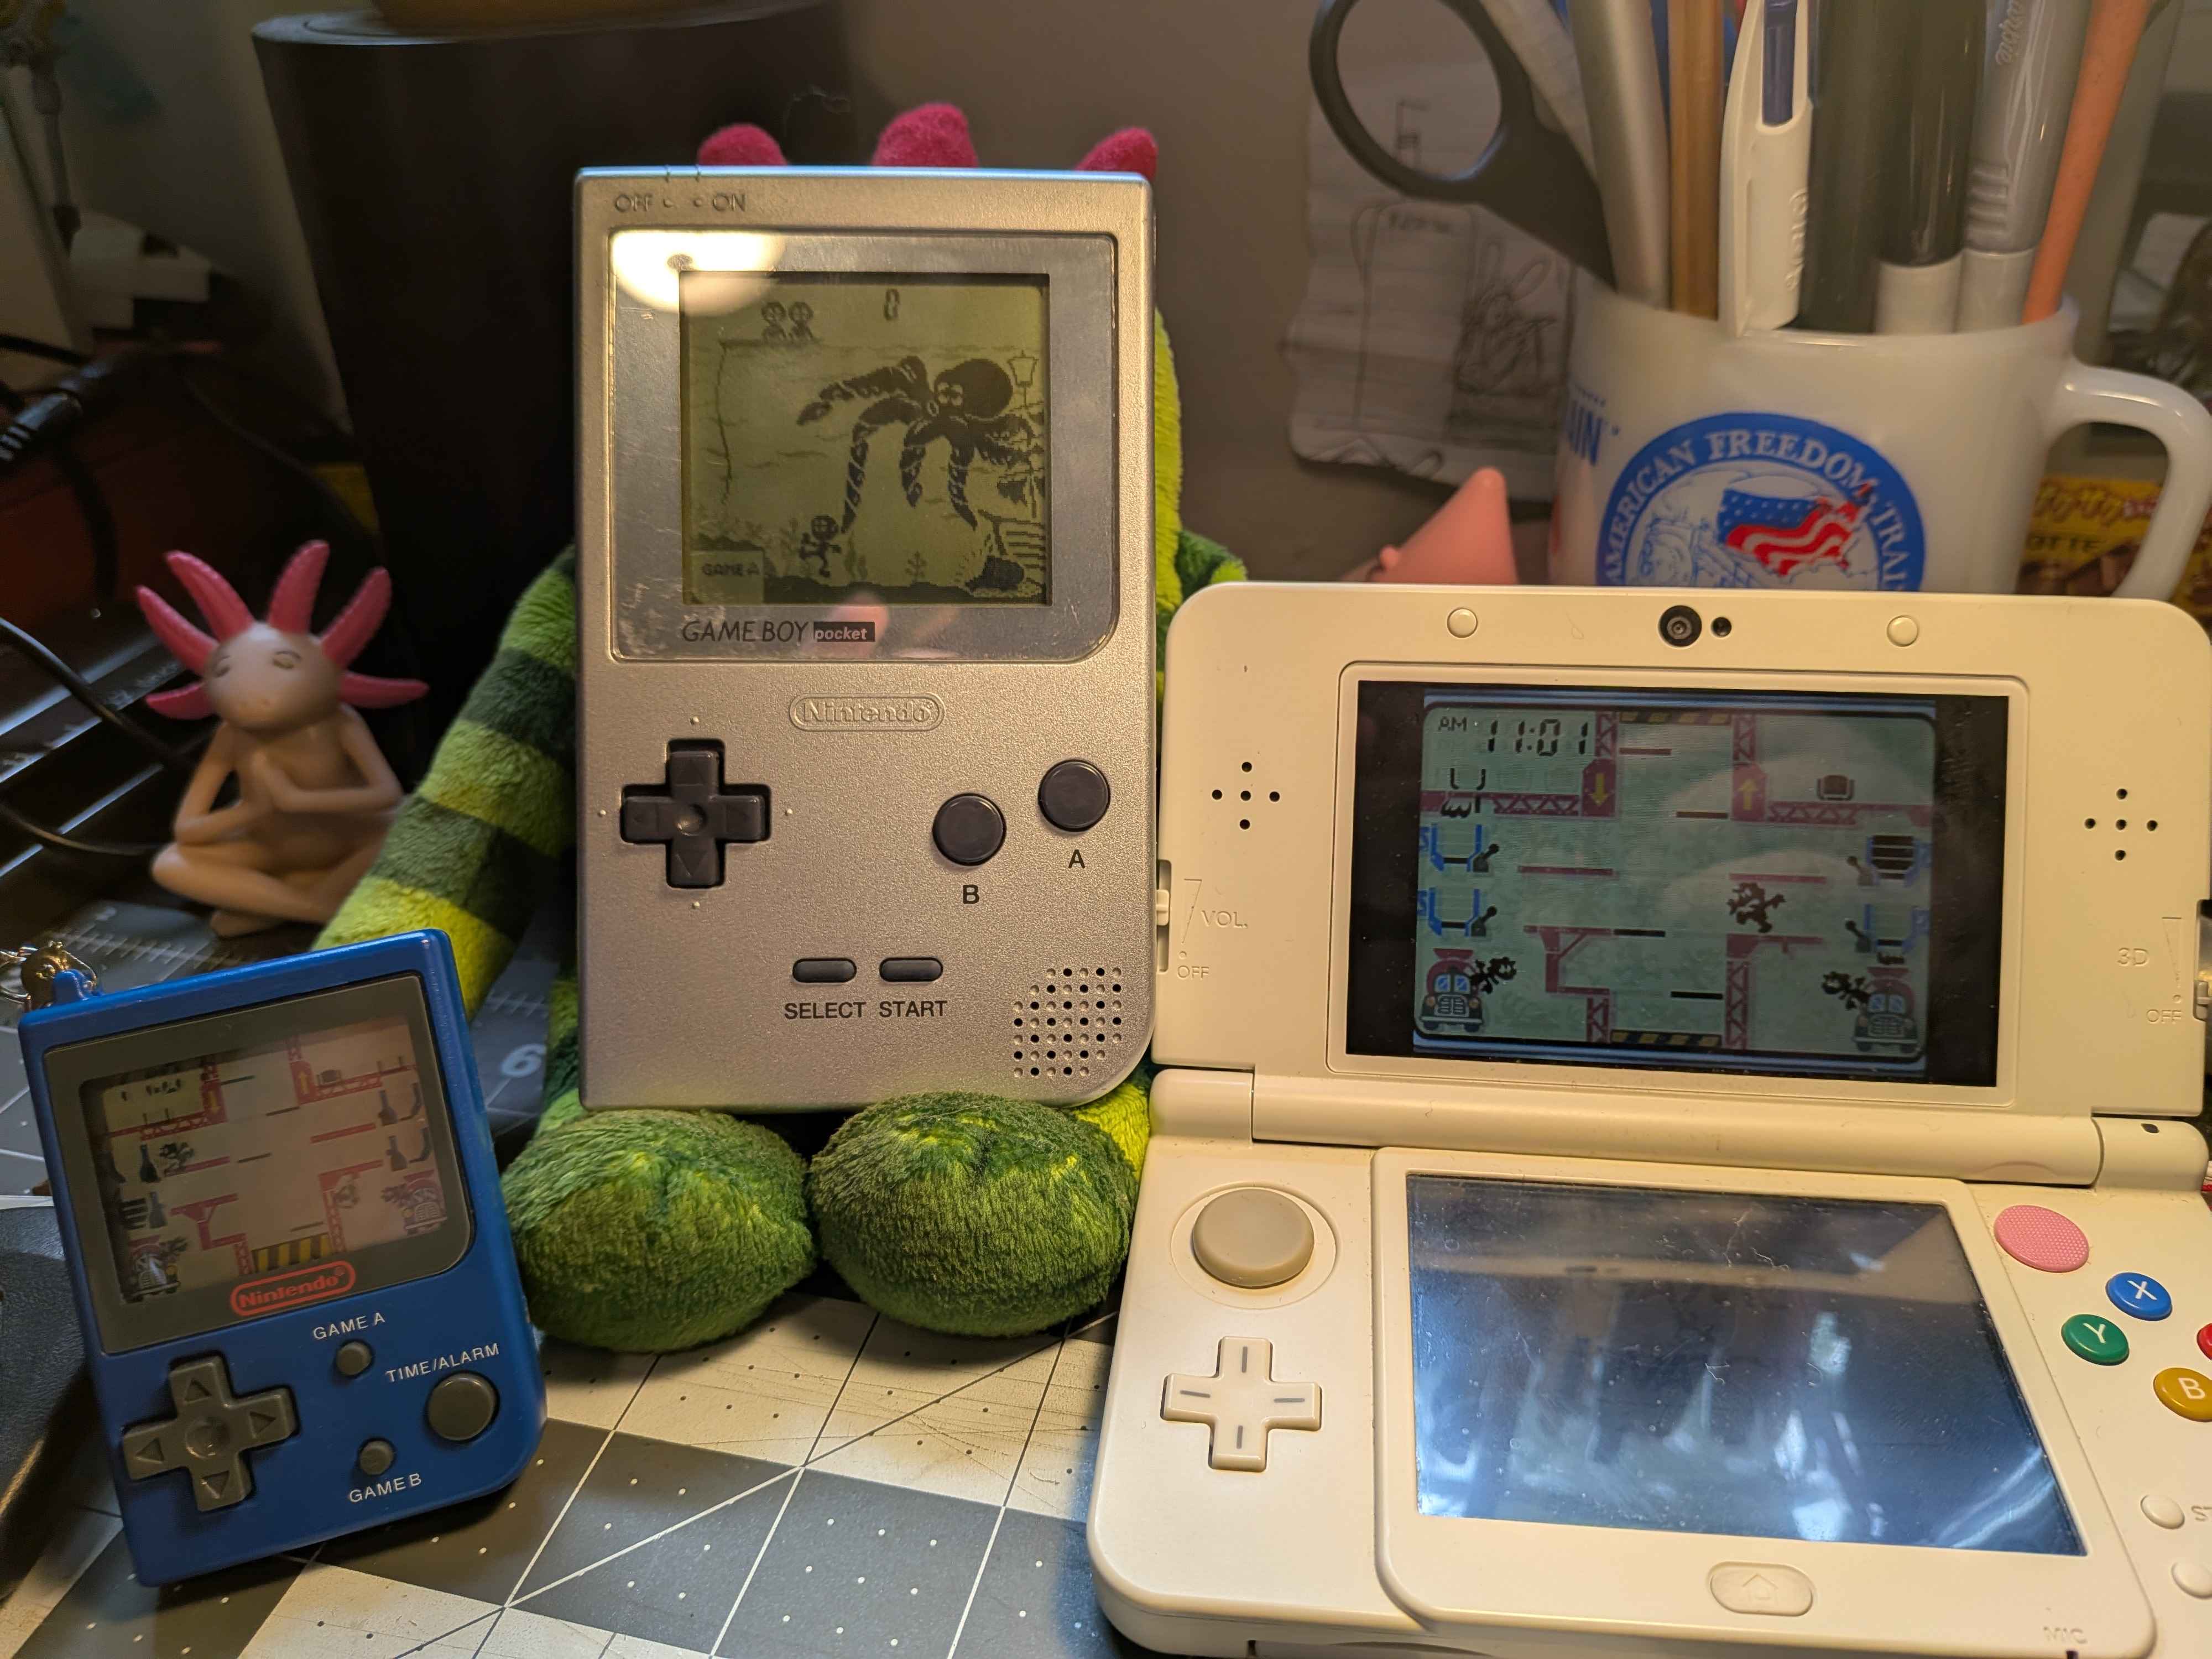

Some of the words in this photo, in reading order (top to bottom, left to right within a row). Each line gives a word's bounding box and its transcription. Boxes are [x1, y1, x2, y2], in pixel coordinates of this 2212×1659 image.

[614, 194, 653, 212] OFF
[712, 194, 747, 212] ON
[1605, 440, 1695, 583] AMERICAN
[1708, 428, 1879, 498] FREEDOM
[1871, 499, 1908, 591] TRAI
[702, 563, 743, 576] GAME
[747, 563, 760, 576] A
[682, 620, 755, 642] GAME
[762, 620, 808, 642] BOY
[815, 626, 868, 641] pocket
[804, 700, 935, 722] Nintendo
[1068, 849, 1086, 869] A
[963, 884, 980, 905] B
[1201, 909, 1248, 929] VOL.
[2117, 947, 2149, 967] 3D
[1177, 965, 1209, 980] OFF
[784, 1001, 867, 1020] SELECT
[879, 1000, 948, 1019] START
[2146, 1009, 2182, 1024] OFF
[501, 1043, 547, 1079] 6
[238, 1274, 341, 1307] Nintendo
[2127, 1279, 2158, 1301] X
[312, 1316, 369, 1340] GAME
[372, 1312, 387, 1327] A
[2082, 1322, 2106, 1344] Y
[385, 1342, 501, 1384] TIME/ALARM
[2178, 1377, 2206, 1400] B
[348, 1478, 406, 1504] GAME
[409, 1473, 422, 1488] B
